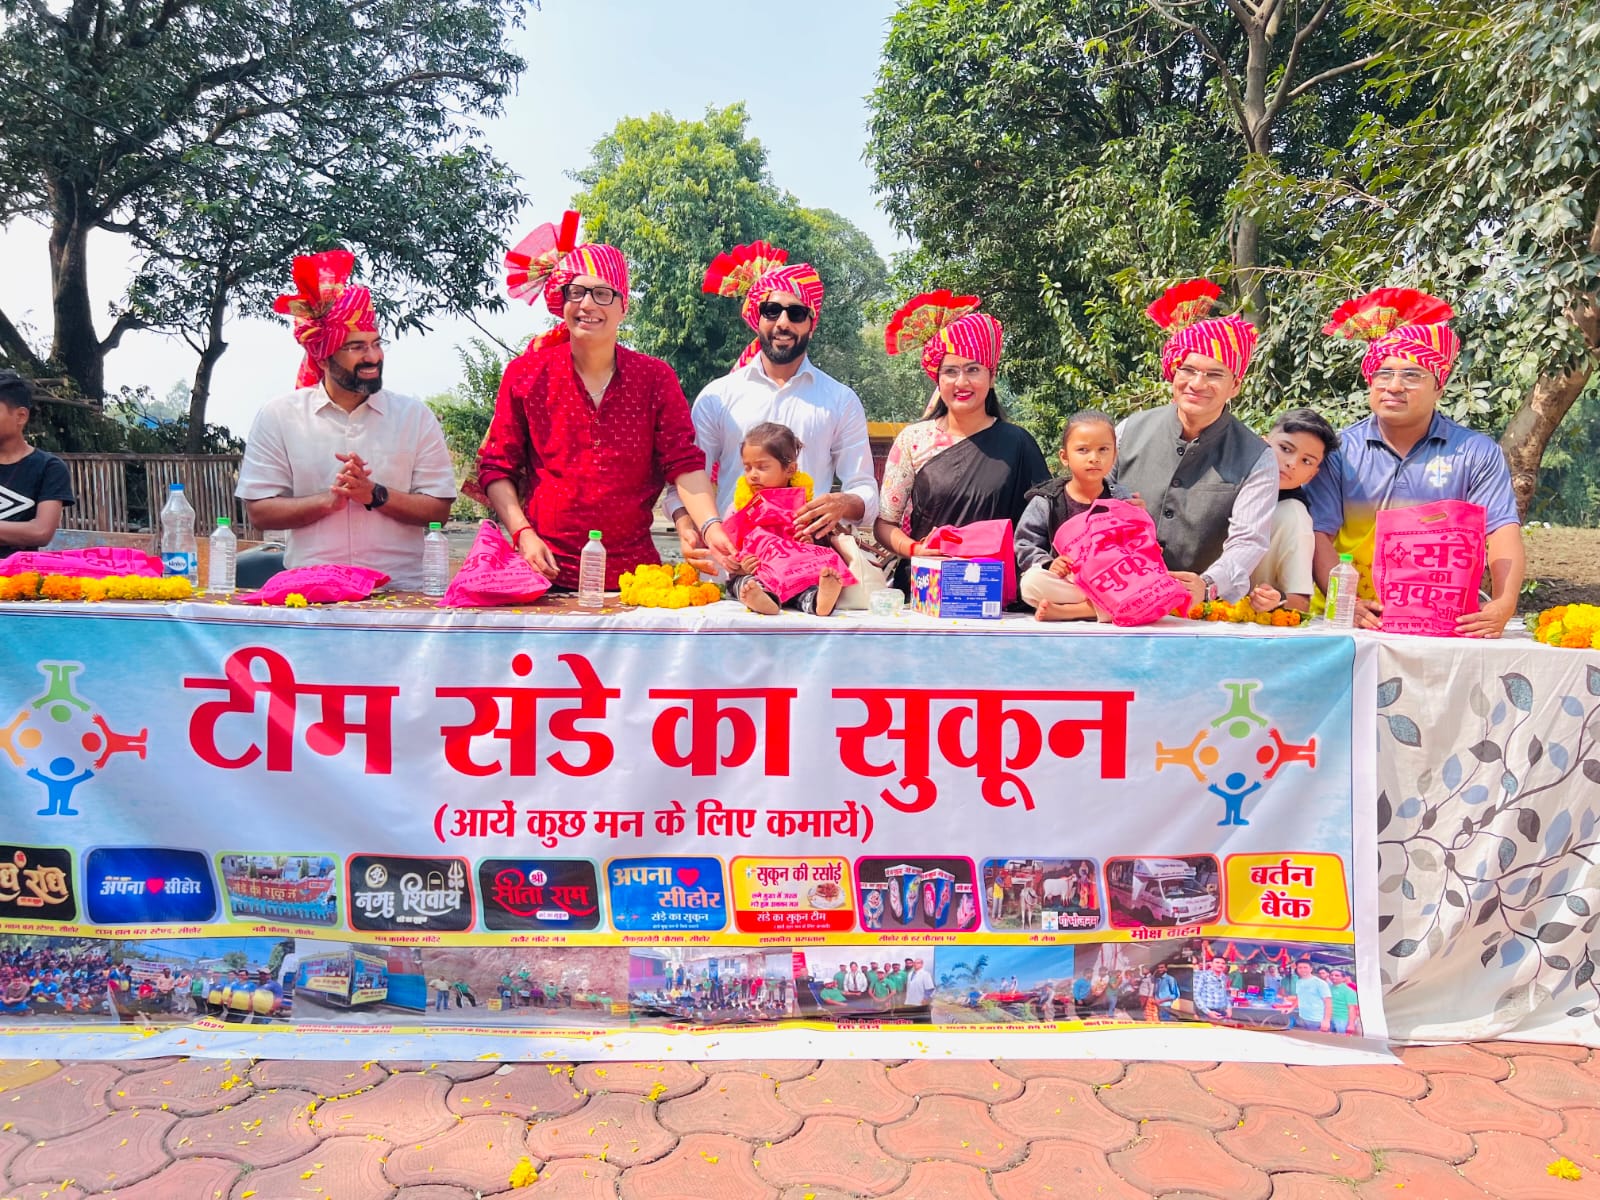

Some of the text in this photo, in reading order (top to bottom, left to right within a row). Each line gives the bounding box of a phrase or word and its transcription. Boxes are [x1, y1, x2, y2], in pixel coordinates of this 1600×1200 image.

[1413, 534, 1474, 569] संडे
[1428, 570, 1452, 583] का
[1385, 582, 1467, 610] सुकून
[184, 646, 1134, 812] टीम संडे का सुकून
[527, 809, 586, 848] कुछ
[594, 811, 644, 838] मन
[654, 801, 686, 837] के
[696, 799, 756, 837] लिए
[531, 872, 544, 883] श्री
[612, 867, 672, 886] अपना
[757, 862, 842, 886] सुकून की रसोई
[1251, 859, 1314, 887] बर्तन
[100, 877, 201, 895] अपना सीहोर
[657, 886, 721, 908] सीहोर
[549, 885, 597, 916] राम
[1261, 891, 1311, 918] बैंक
[772, 913, 784, 922] का
[810, 911, 826, 921] टीम
[1131, 926, 1162, 939] मोक्ष
